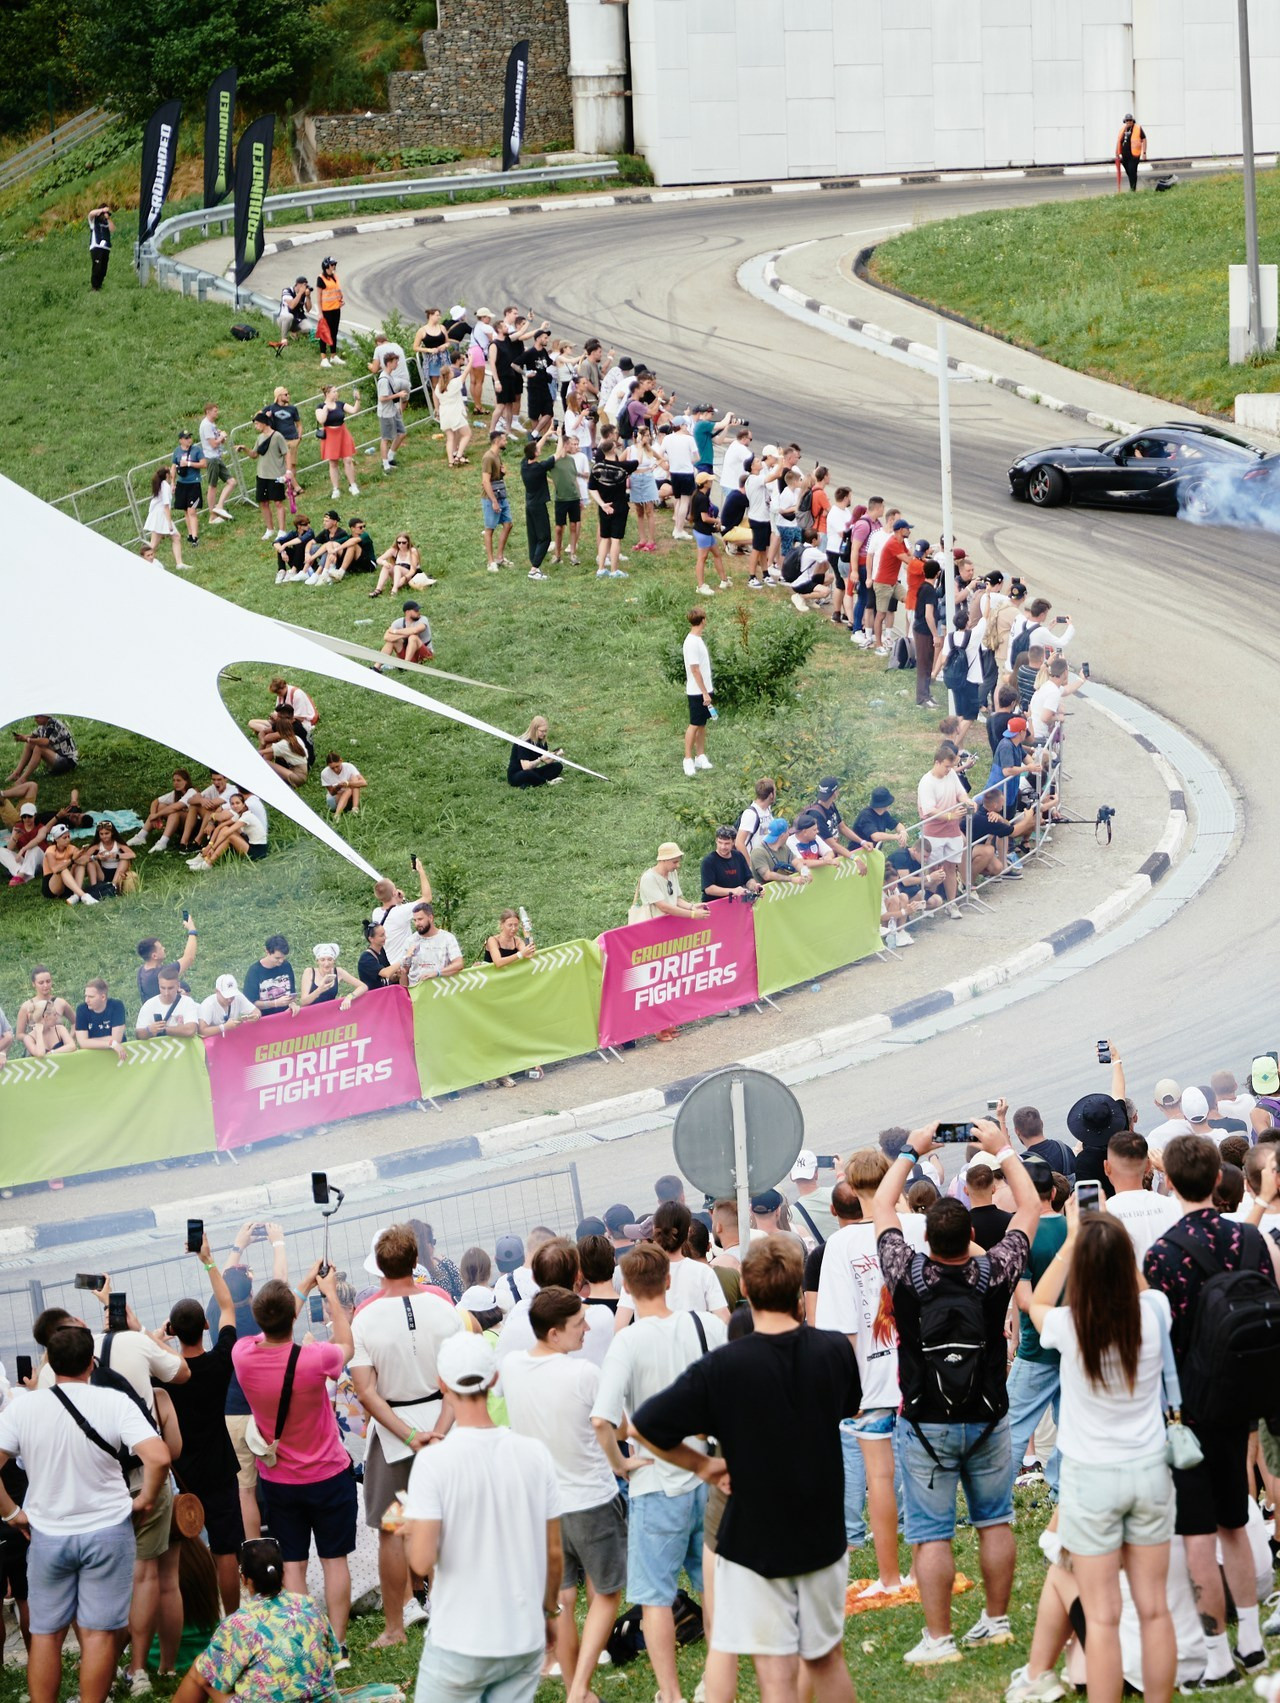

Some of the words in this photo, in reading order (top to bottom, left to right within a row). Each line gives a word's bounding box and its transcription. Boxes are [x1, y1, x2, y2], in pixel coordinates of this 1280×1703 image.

[218, 91, 230, 177] GROUNDED
[149, 123, 172, 216] GROUNDED
[632, 929, 711, 965] GROUNDED
[645, 942, 722, 984] DRIFT
[634, 962, 737, 1011] FIGHTERS
[255, 1023, 357, 1063] GROUNDED
[272, 1037, 372, 1083] DRIFT
[259, 1058, 392, 1110] FIGHTERS
